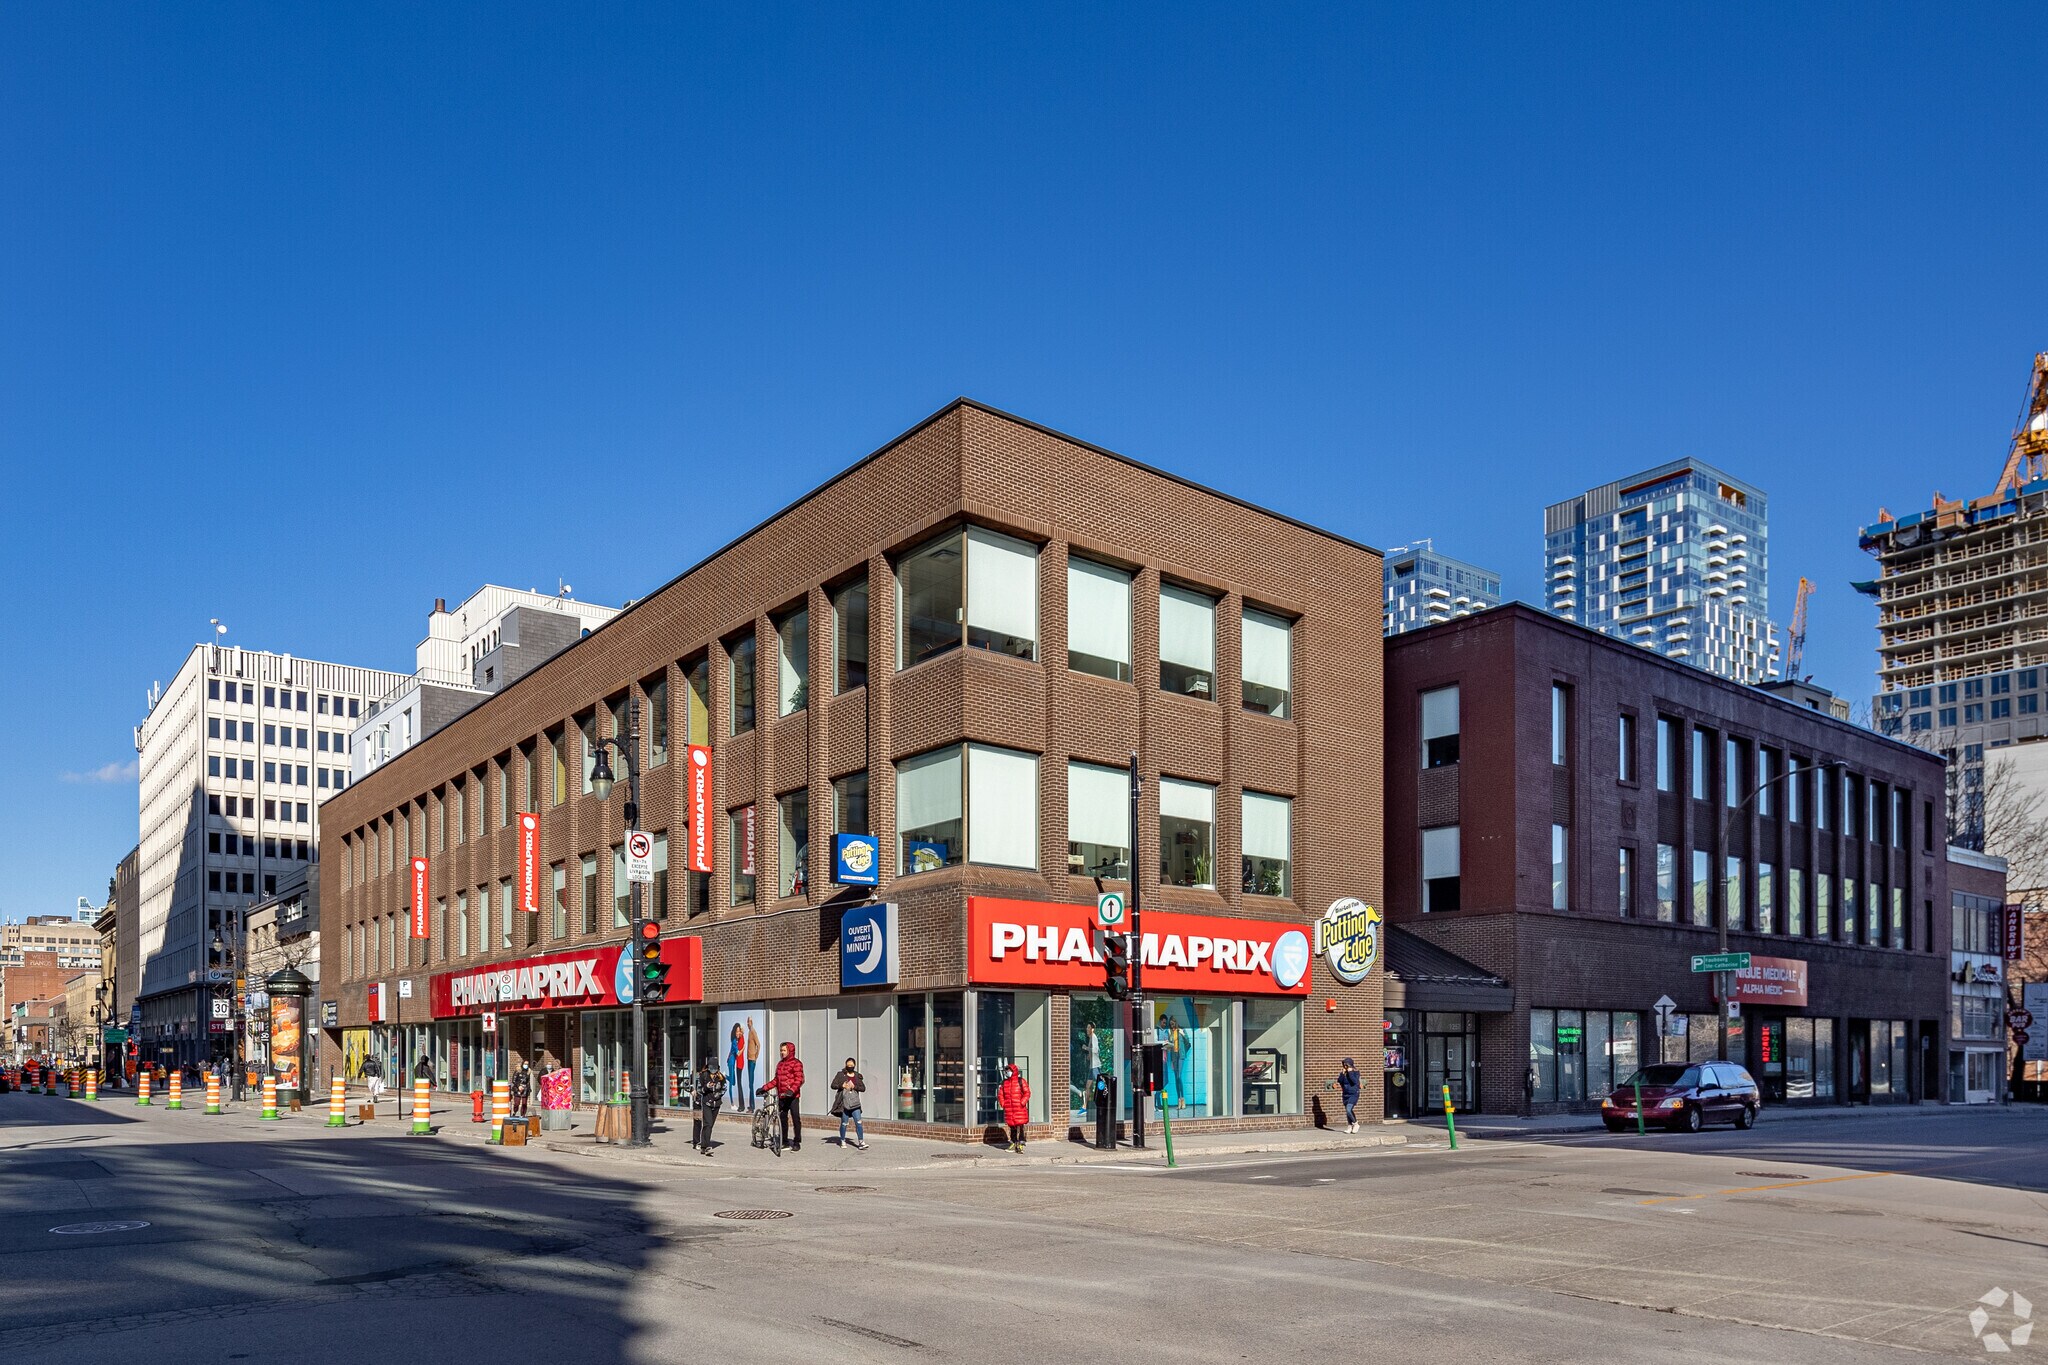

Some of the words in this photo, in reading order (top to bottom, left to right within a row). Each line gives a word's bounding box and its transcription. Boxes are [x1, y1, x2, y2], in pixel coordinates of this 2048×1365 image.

[696, 768, 709, 871] PHARMAPRIX
[842, 845, 867, 860] Putting
[525, 831, 535, 911] PHARMAPRIX
[848, 924, 871, 935] OUVERT
[1322, 911, 1366, 949] Putting
[2007, 912, 2021, 959] ANDREW'S
[853, 934, 871, 942] JUSQU'À
[846, 941, 871, 953] MINUIT
[1345, 934, 1373, 964] Edge
[1693, 958, 1703, 970] P
[1735, 967, 1762, 979] NIQUE
[1762, 965, 1797, 982] MÉDICALE
[1743, 984, 1765, 994] ALPHA
[1765, 983, 1783, 995] MÉDIC
[214, 1003, 228, 1013] 30
[2009, 1015, 2028, 1023] BAR
